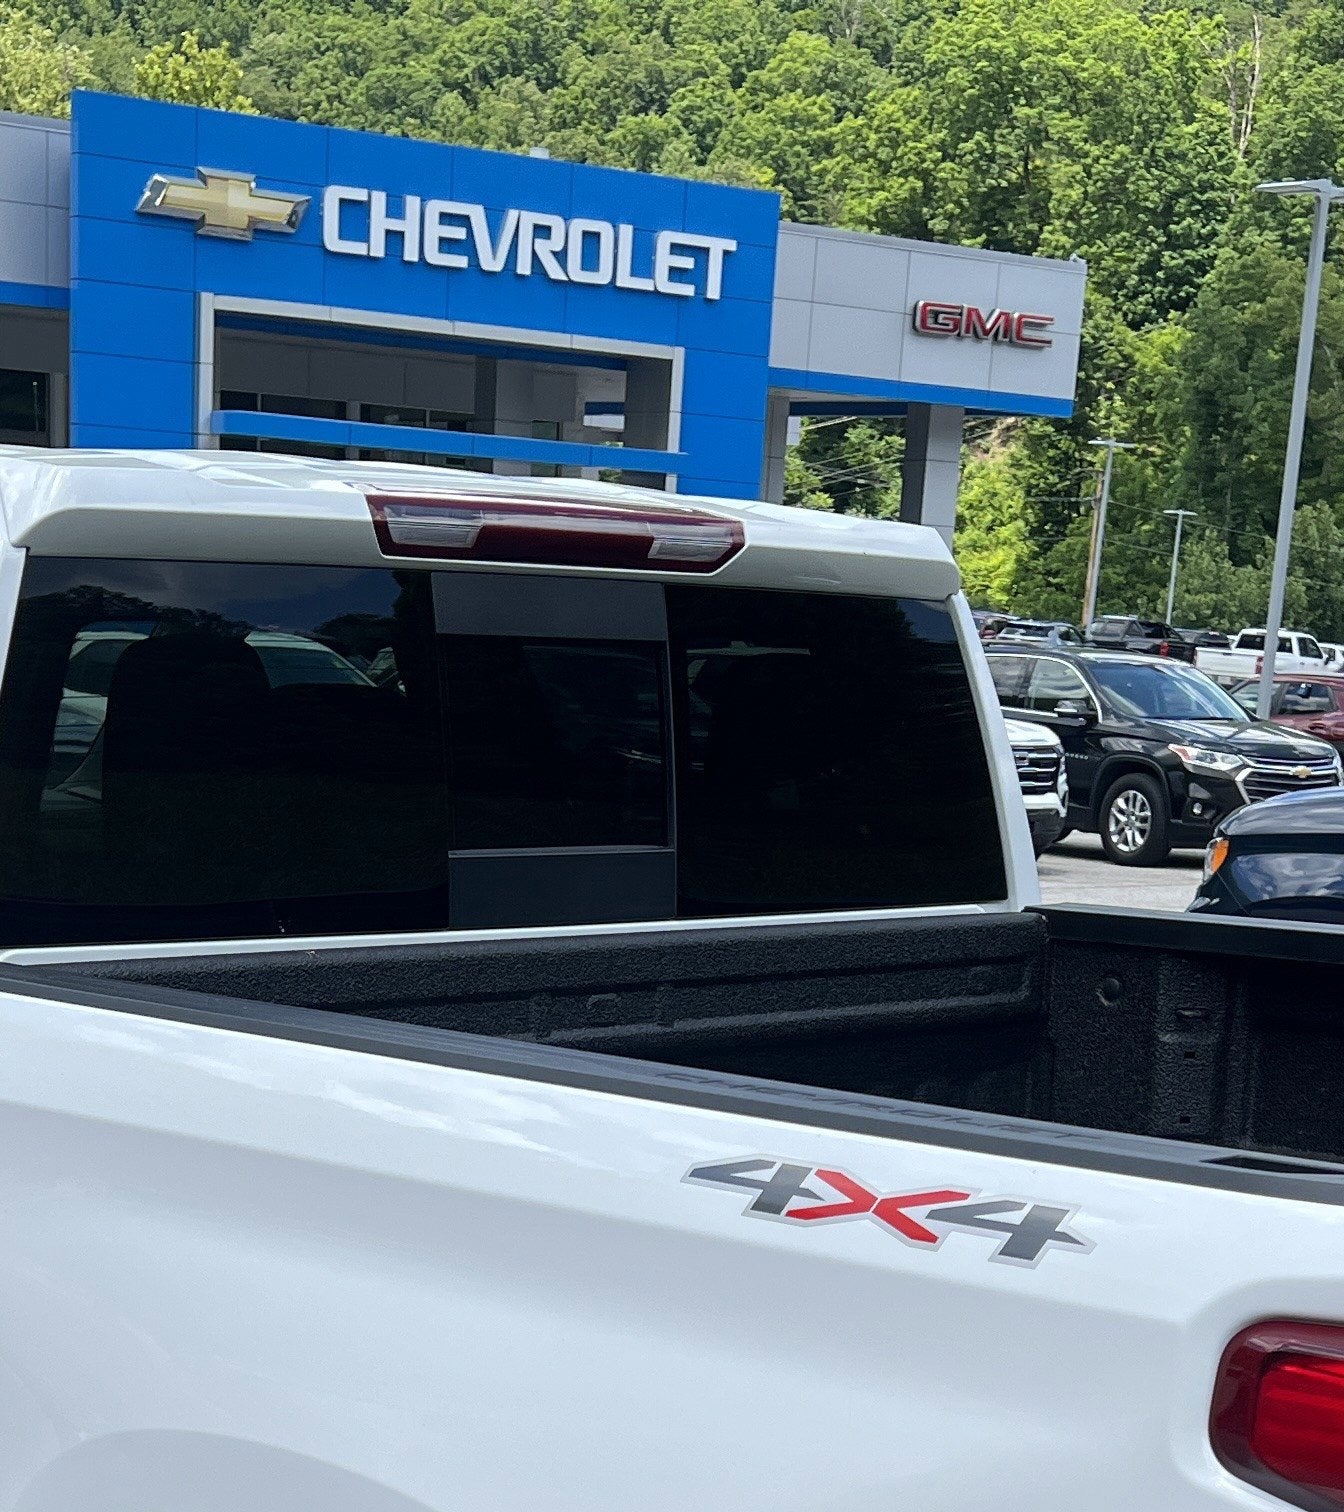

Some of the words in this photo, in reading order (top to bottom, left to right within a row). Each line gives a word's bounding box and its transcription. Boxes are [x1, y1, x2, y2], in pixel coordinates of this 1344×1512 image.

[322, 185, 738, 300] CHEVROLET
[914, 300, 1055, 347] GMC
[657, 1072, 1101, 1140] CHEVROLET
